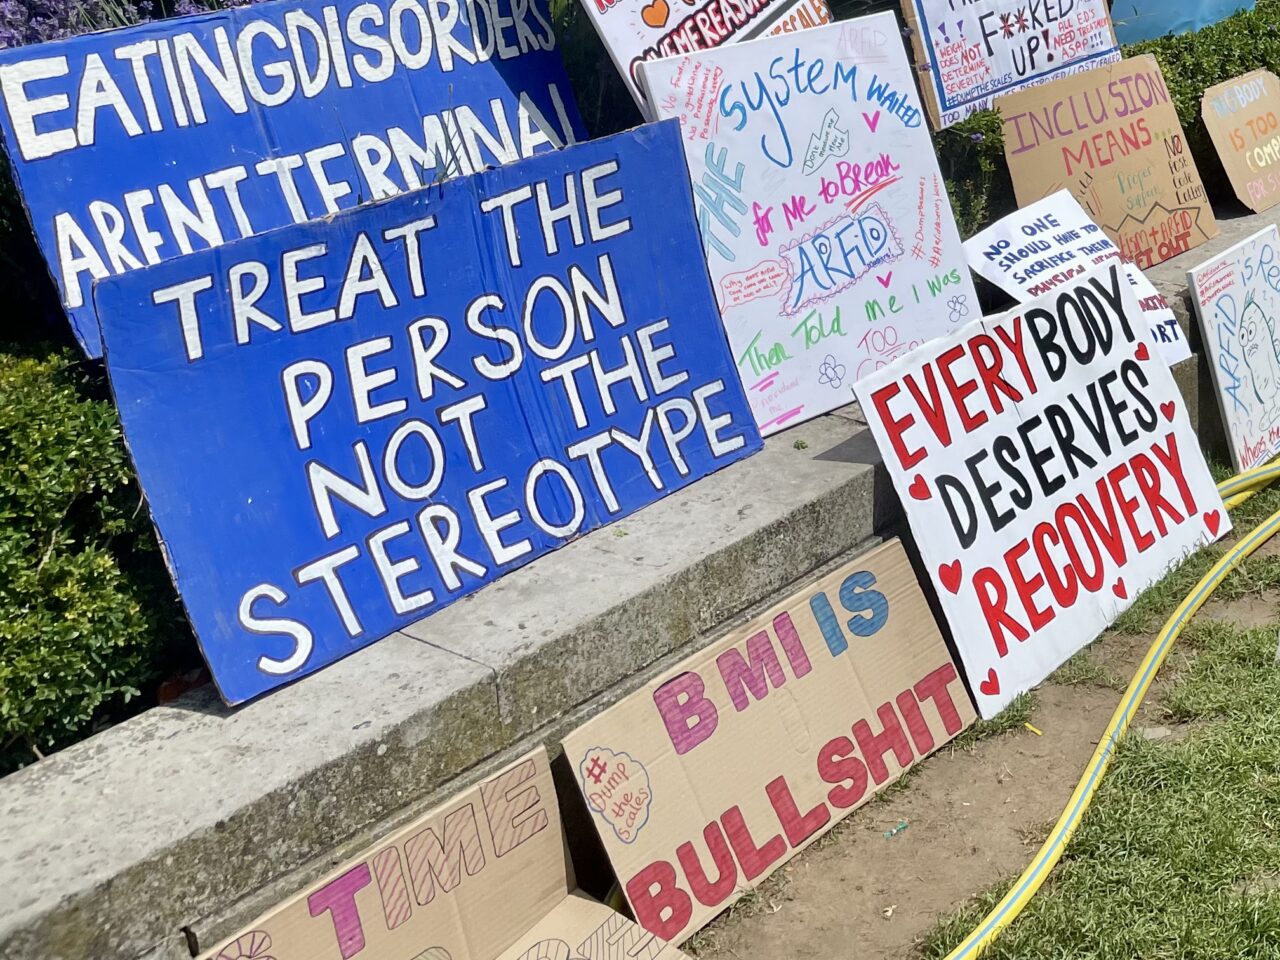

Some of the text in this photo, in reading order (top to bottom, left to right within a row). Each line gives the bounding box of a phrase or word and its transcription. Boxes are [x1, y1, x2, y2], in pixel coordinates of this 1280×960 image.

[1054, 29, 1075, 50] NEED
[1058, 19, 1073, 32] ALL
[940, 43, 981, 69] DOES NOT
[941, 58, 985, 83] DETERMINE
[1012, 29, 1053, 76] UP!
[946, 73, 1012, 107] #DUMPTHESCALES
[1004, 70, 1169, 155] INCLUSION
[941, 110, 960, 125] TOO
[1229, 112, 1278, 152] IS TOO
[1164, 134, 1183, 159] NO
[694, 142, 748, 262] THE
[751, 176, 840, 247] for Me to
[1246, 179, 1267, 206] FOR
[982, 213, 1061, 262] NO ONE
[998, 223, 1099, 273] SHOULD HAVE TO
[1158, 231, 1191, 261] OUT
[1161, 210, 1193, 241] ARFID
[154, 161, 630, 361] TREAT THE
[1013, 250, 1077, 285] SACRIFICE
[1077, 239, 1113, 257] THEIR
[738, 267, 962, 378] Then Told Was
[857, 326, 898, 355] TOO
[281, 257, 625, 448] PERSON
[871, 265, 1136, 472] EVERYBODY
[307, 395, 486, 538] NOT
[541, 320, 688, 428] THE
[935, 358, 1159, 550] DESERVES
[239, 380, 744, 675] STEREOTYPE
[971, 432, 1199, 658] RECOVERY
[653, 571, 889, 755] BMI IS
[589, 762, 629, 813] Dump
[612, 792, 632, 818] the
[626, 662, 964, 942] BULLSHIT
[618, 788, 649, 840] scales
[307, 759, 548, 959] TIME
